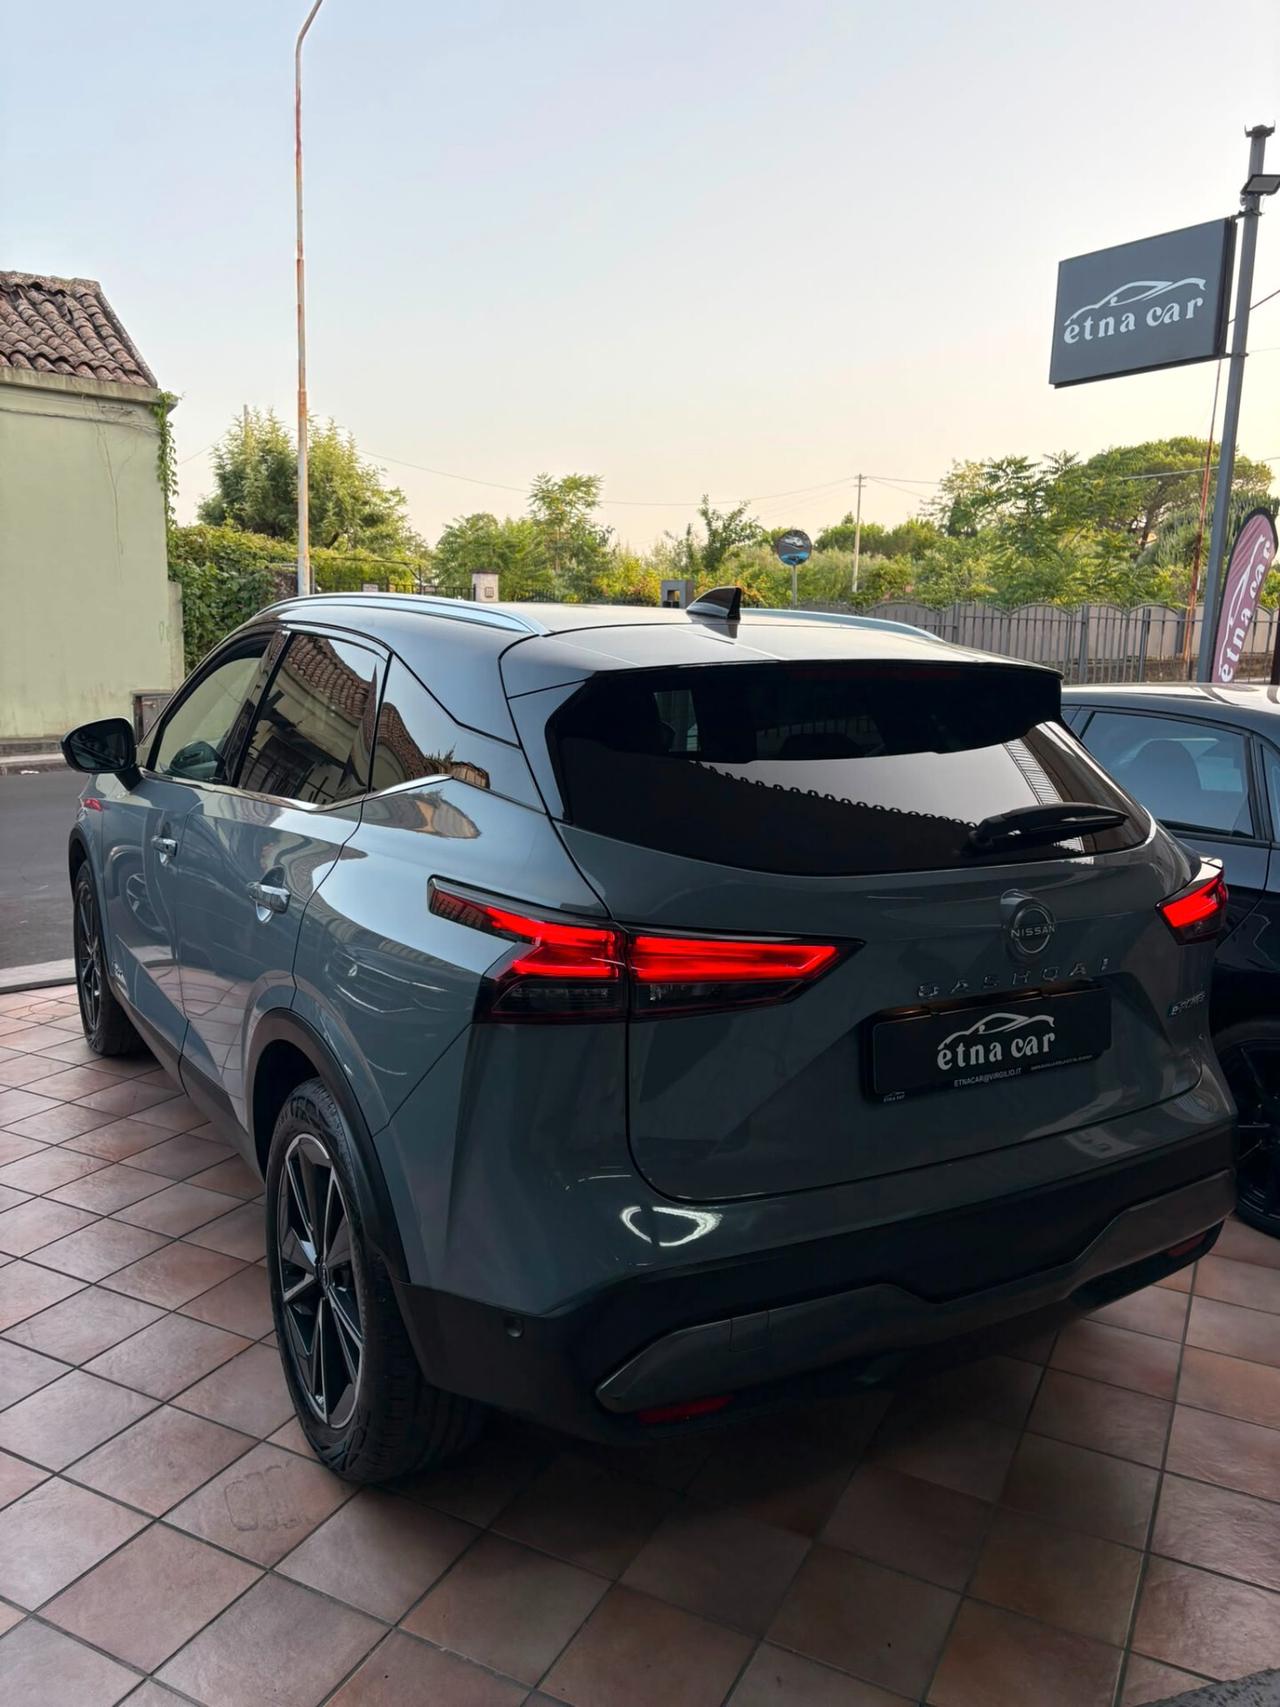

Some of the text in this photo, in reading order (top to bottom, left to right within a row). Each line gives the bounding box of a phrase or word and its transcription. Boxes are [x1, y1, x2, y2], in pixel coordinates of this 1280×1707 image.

[1063, 297, 1204, 344] etna car
[1221, 540, 1271, 682] etna car
[1010, 924, 1056, 938] NISSAN
[937, 1041, 1002, 1070] etna
[1011, 1032, 1056, 1058] car
[953, 1067, 1022, 1087] ETNACAR@VIRGILIO.IT
